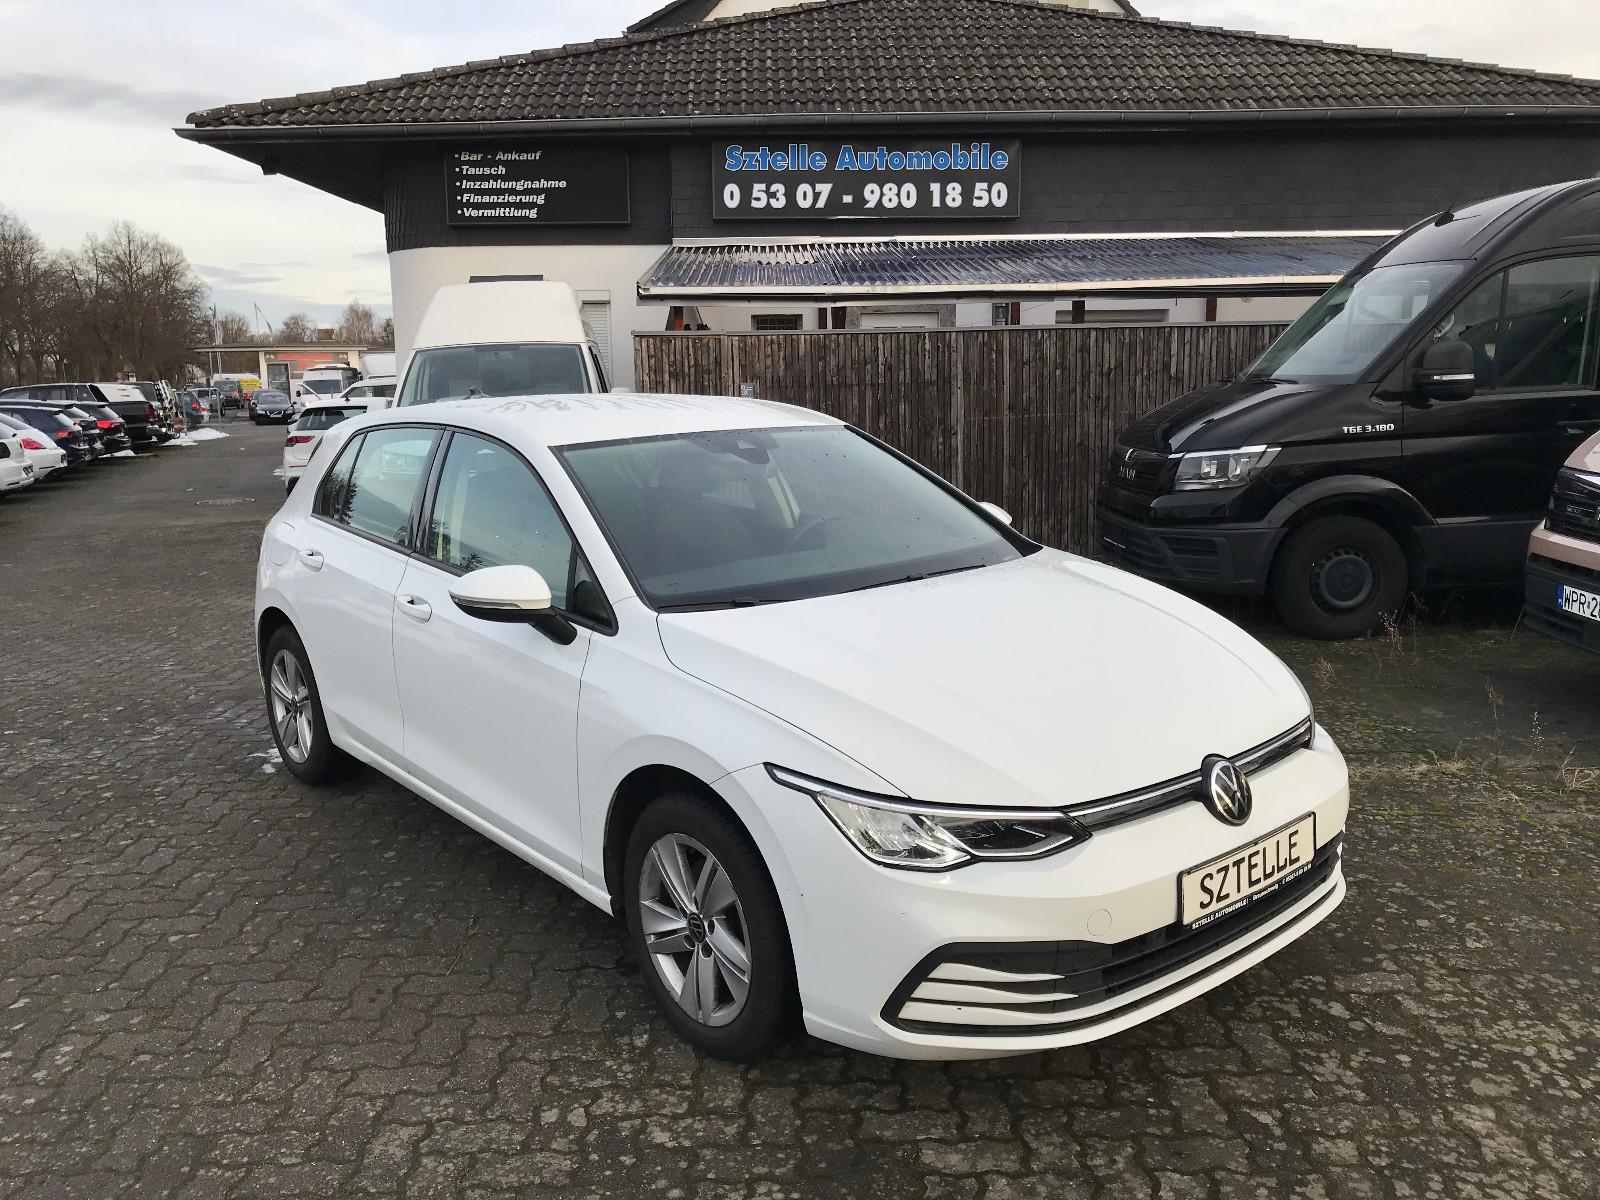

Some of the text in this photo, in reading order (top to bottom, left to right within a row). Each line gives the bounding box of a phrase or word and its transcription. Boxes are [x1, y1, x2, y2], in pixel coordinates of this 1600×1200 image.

[460, 151, 484, 161] Bar
[495, 150, 543, 161] Ankauf
[724, 142, 1009, 172] Sztelle Automobile
[461, 165, 506, 175] Tausch
[461, 179, 567, 190] Inzahlungnahme
[462, 193, 546, 205] Finanzierung
[723, 182, 741, 209] 0
[750, 182, 787, 209] 53
[795, 182, 834, 209] 07
[863, 182, 918, 209] 980
[929, 181, 963, 209] 18
[972, 181, 1008, 208] 50
[463, 207, 538, 219] Vermittlung
[1341, 423, 1395, 434] TGE 3.180
[1199, 829, 1301, 910] SZTELLE
